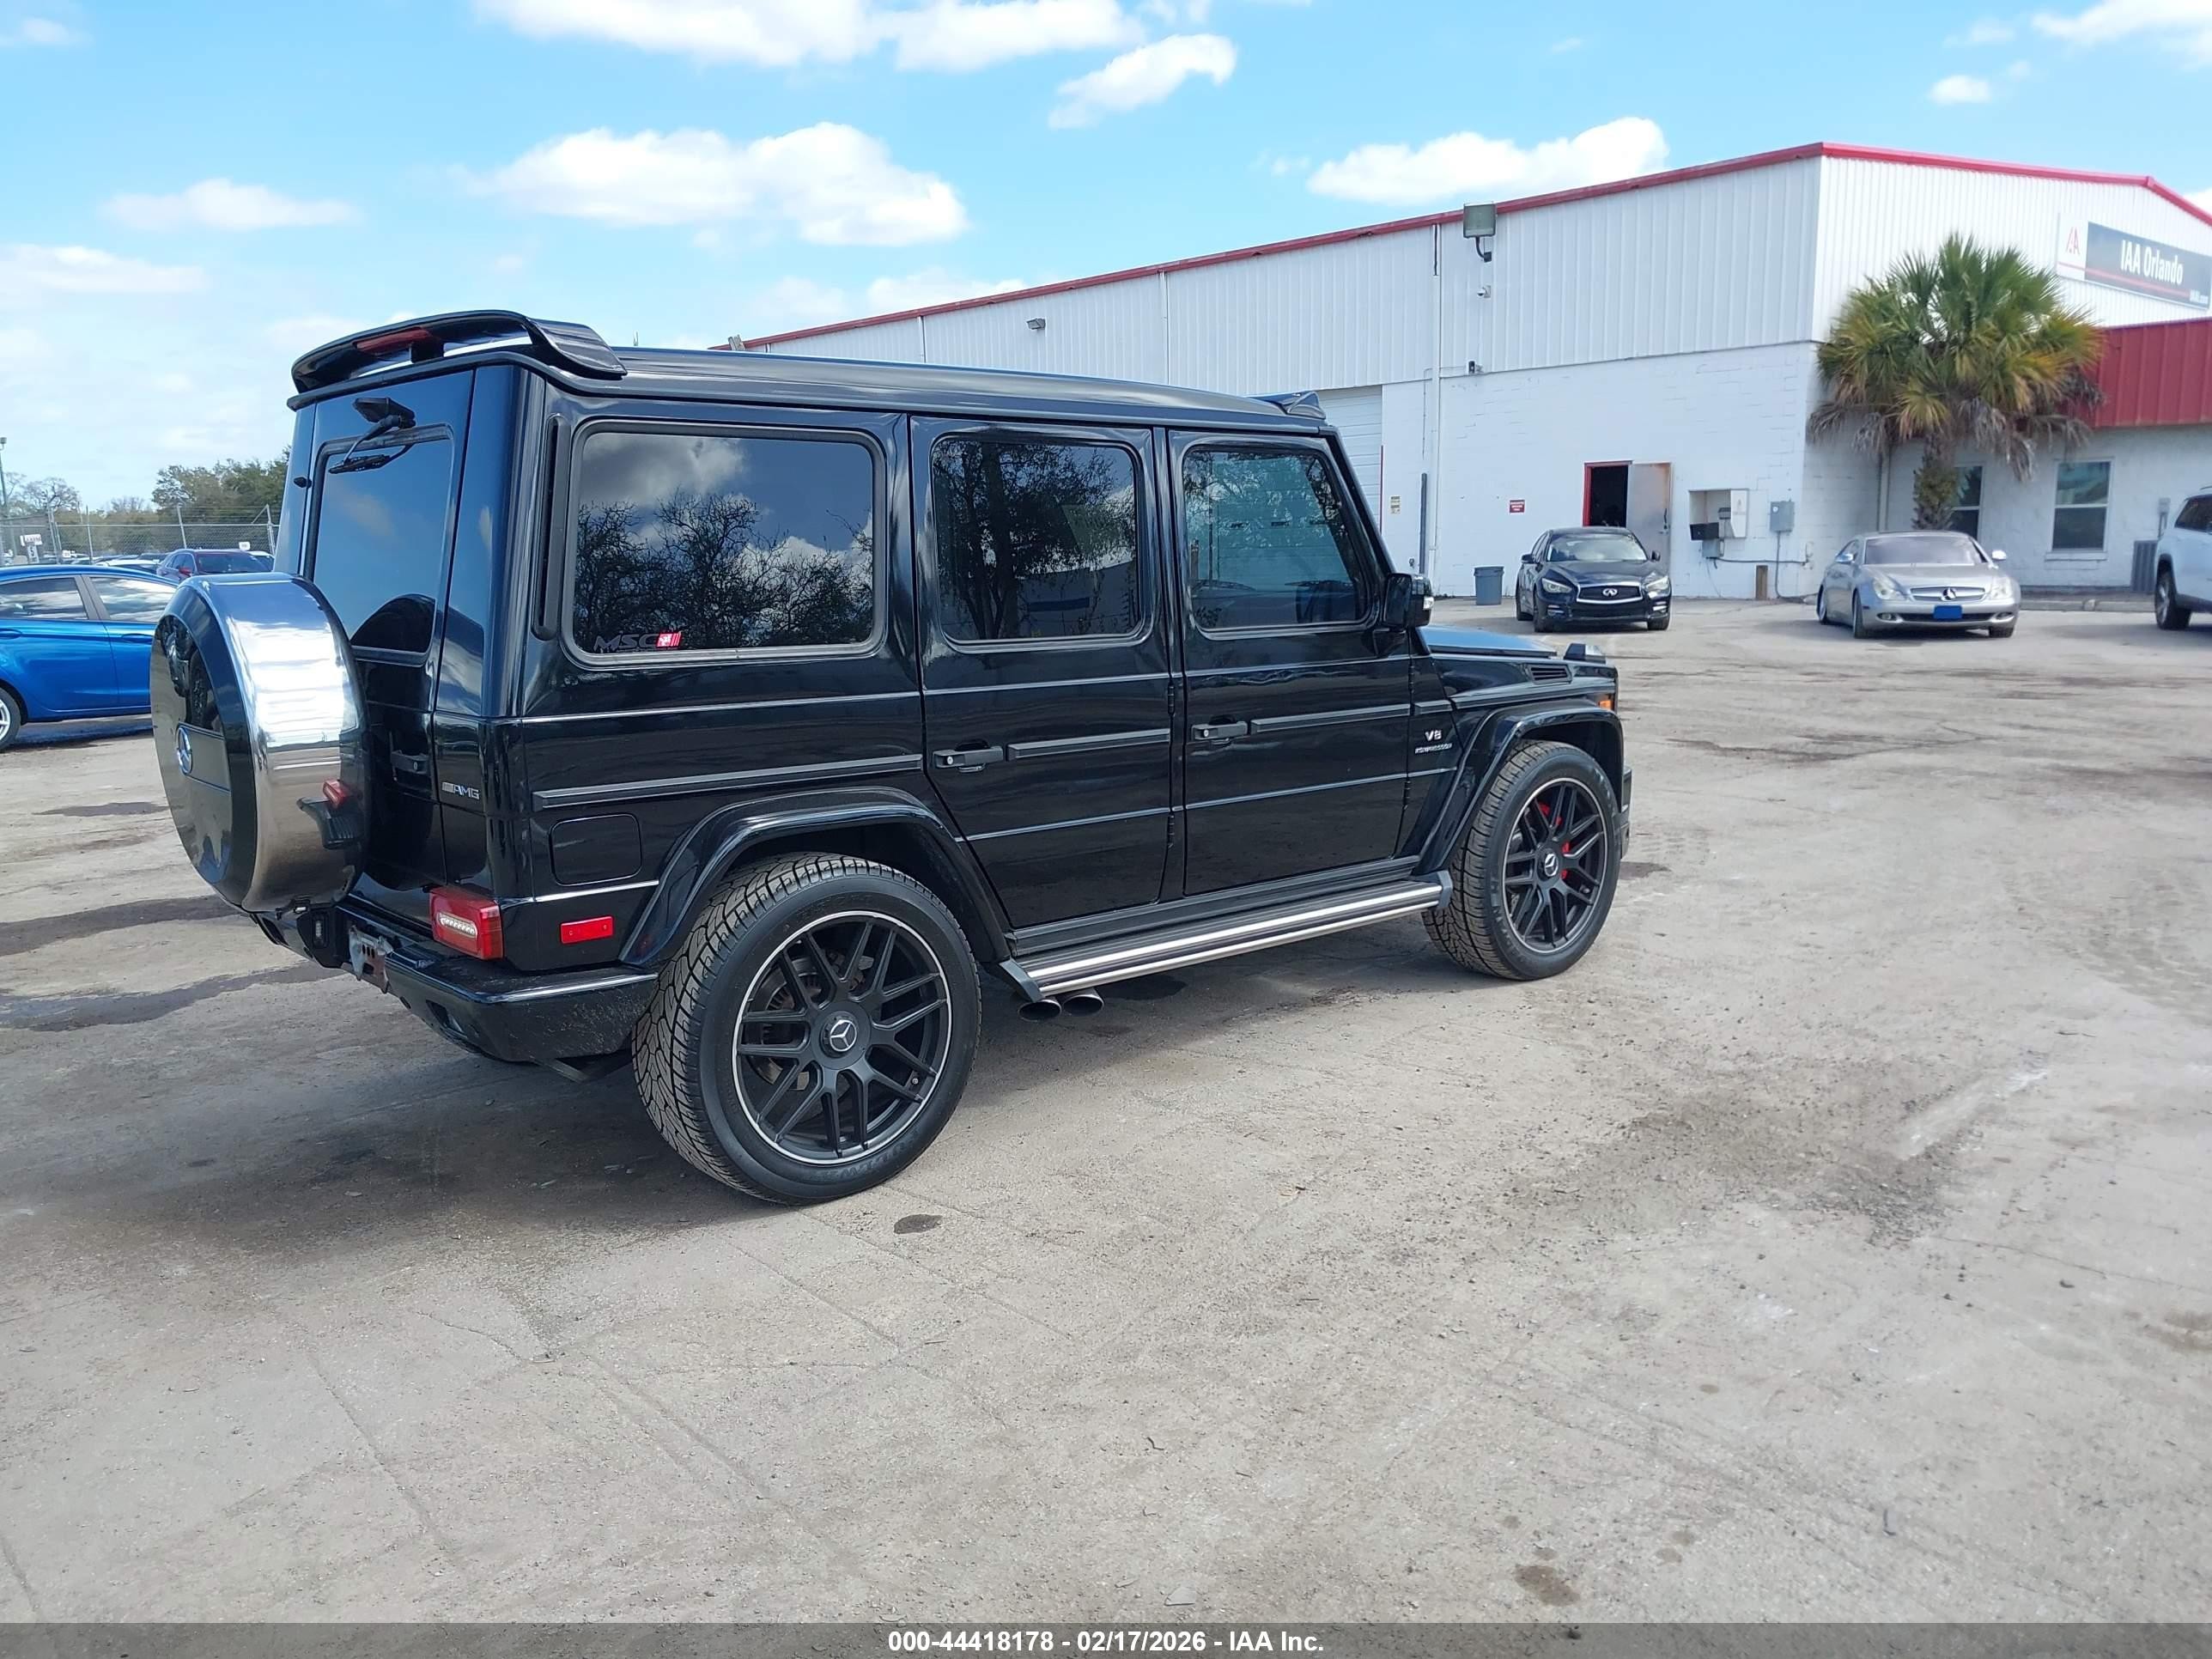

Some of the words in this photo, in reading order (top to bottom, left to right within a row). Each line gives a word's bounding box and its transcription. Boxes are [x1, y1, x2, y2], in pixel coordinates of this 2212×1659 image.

[2120, 240, 2141, 275] IAA
[2143, 246, 2184, 285] Orlando
[1425, 730, 1442, 741] V8
[453, 784, 480, 800] AMG
